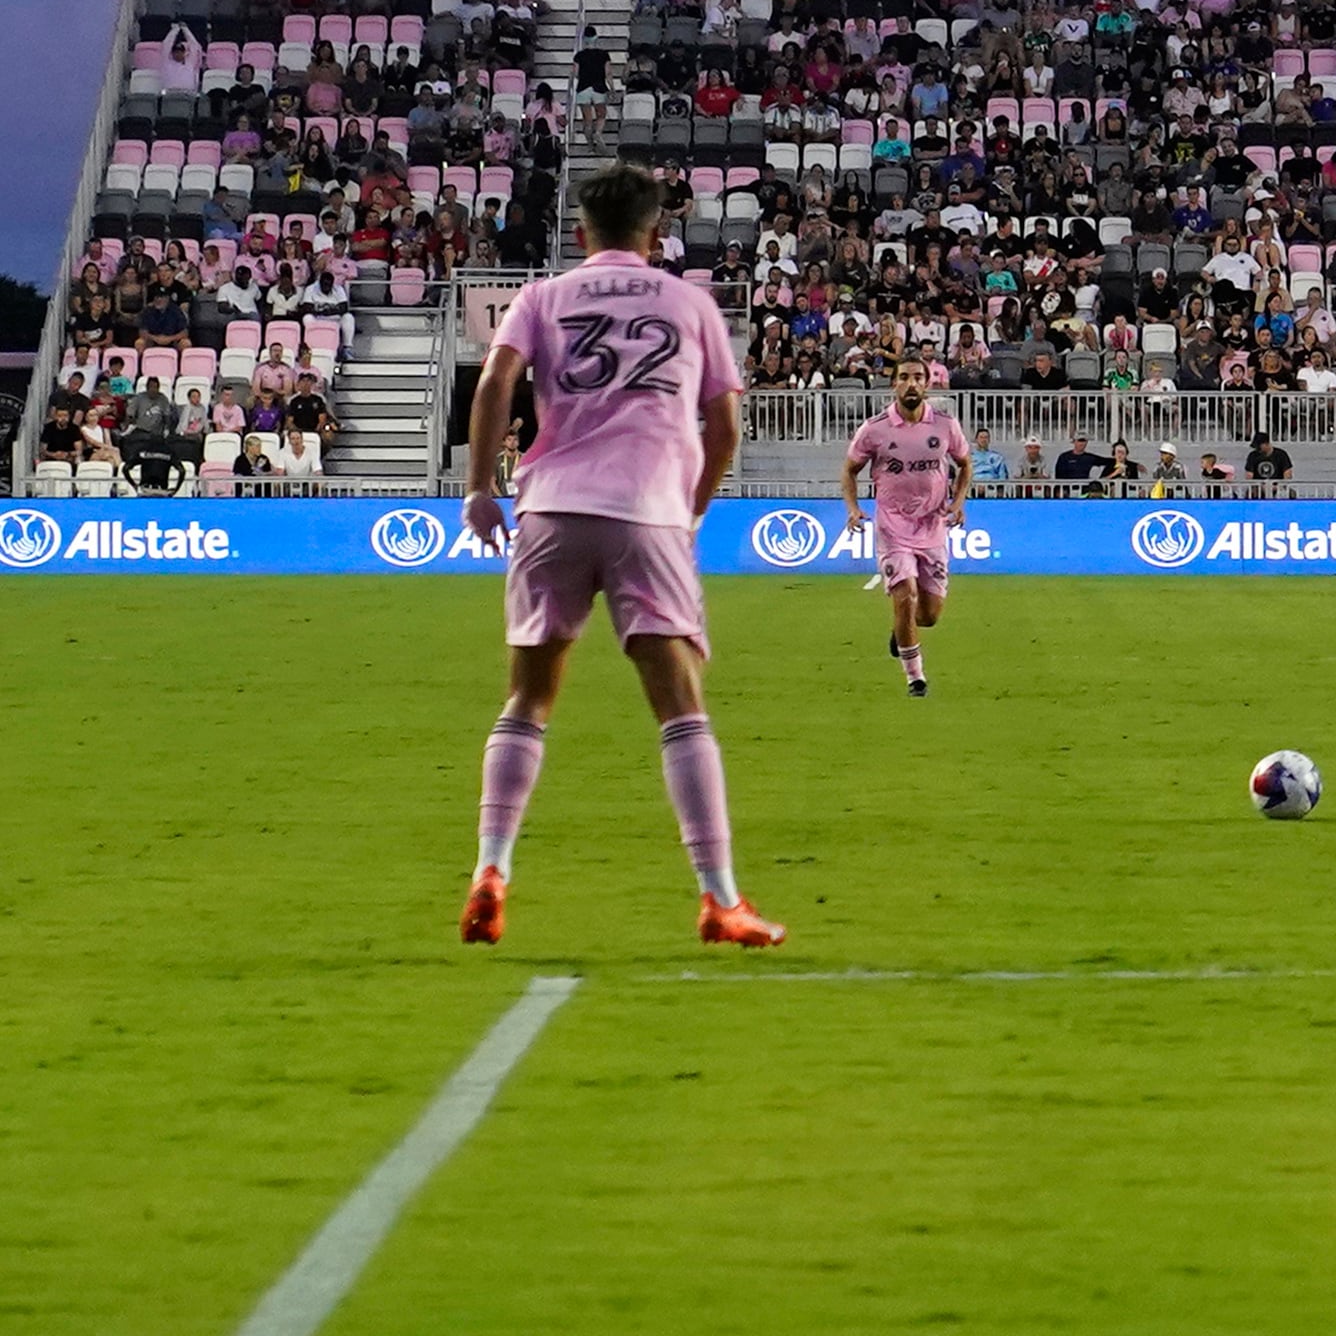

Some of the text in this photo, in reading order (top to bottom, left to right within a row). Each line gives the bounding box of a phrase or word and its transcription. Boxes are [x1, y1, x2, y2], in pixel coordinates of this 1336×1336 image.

[576, 278, 663, 300] ALLEN
[556, 313, 681, 396] 32
[64, 520, 230, 561] Allstate
